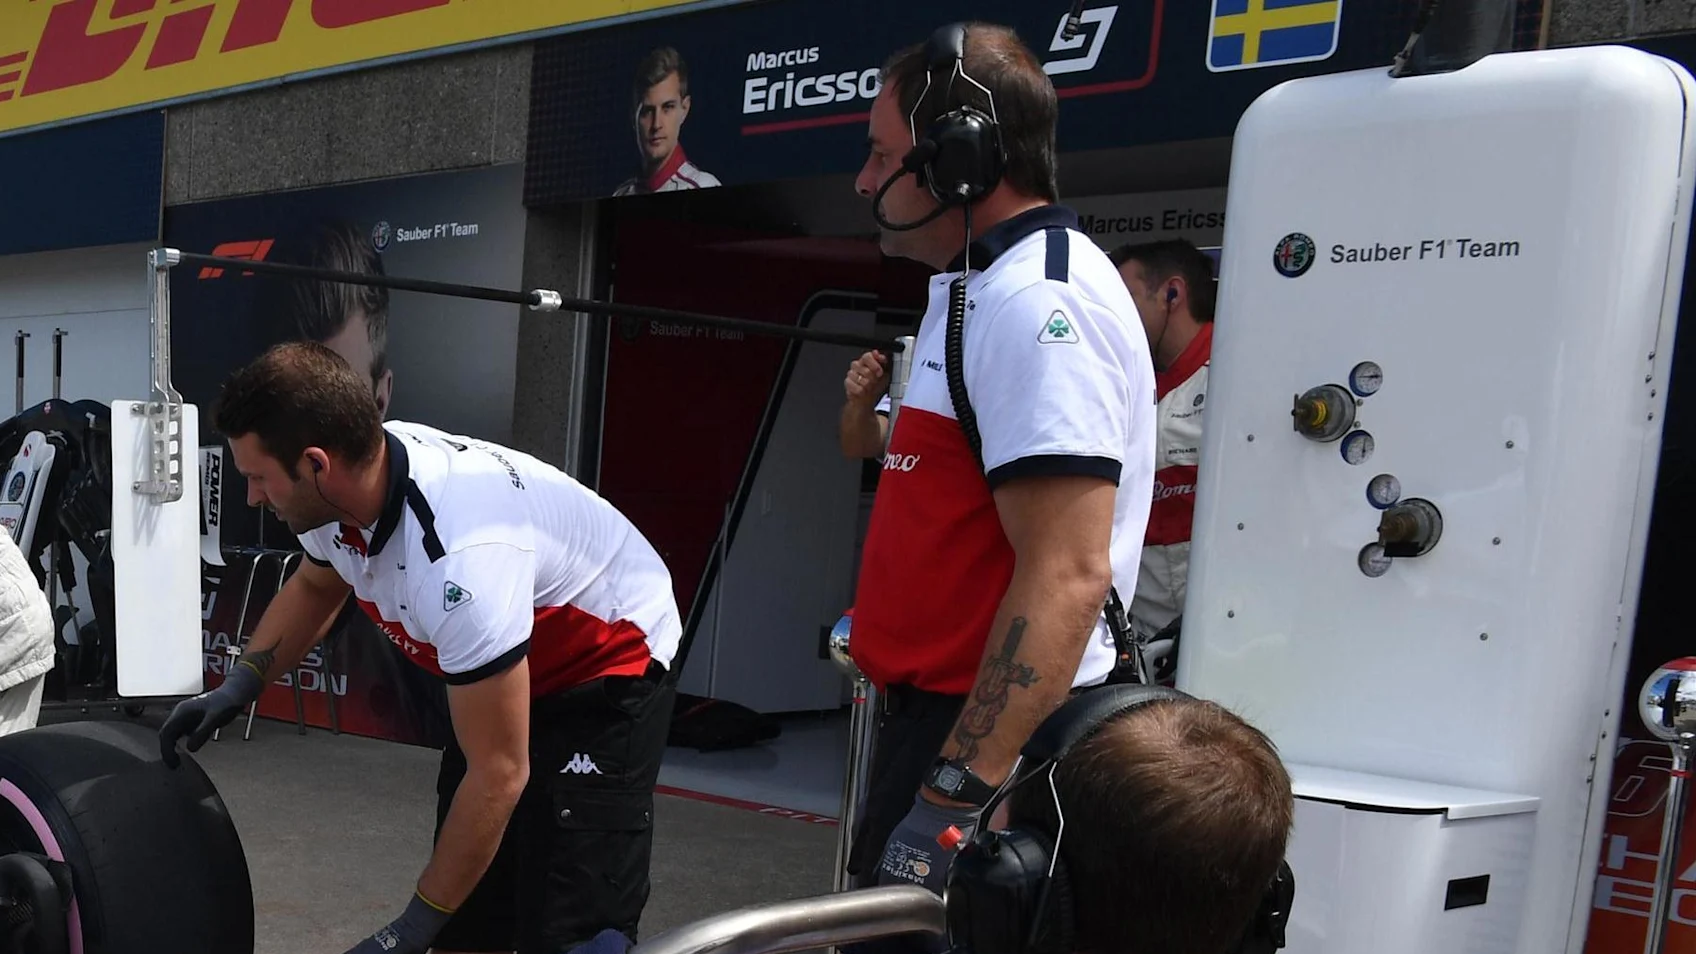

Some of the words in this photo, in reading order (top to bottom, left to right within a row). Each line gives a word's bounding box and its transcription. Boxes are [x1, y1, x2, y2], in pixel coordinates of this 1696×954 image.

[746, 45, 820, 72] Marcus
[741, 66, 883, 115] Ericsso
[396, 226, 432, 243] Sauber
[449, 222, 479, 237] Team
[1077, 214, 1154, 235] Marcus
[1161, 208, 1226, 231] Ericss
[1330, 242, 1412, 264] Sauber
[1455, 237, 1521, 259] Team
